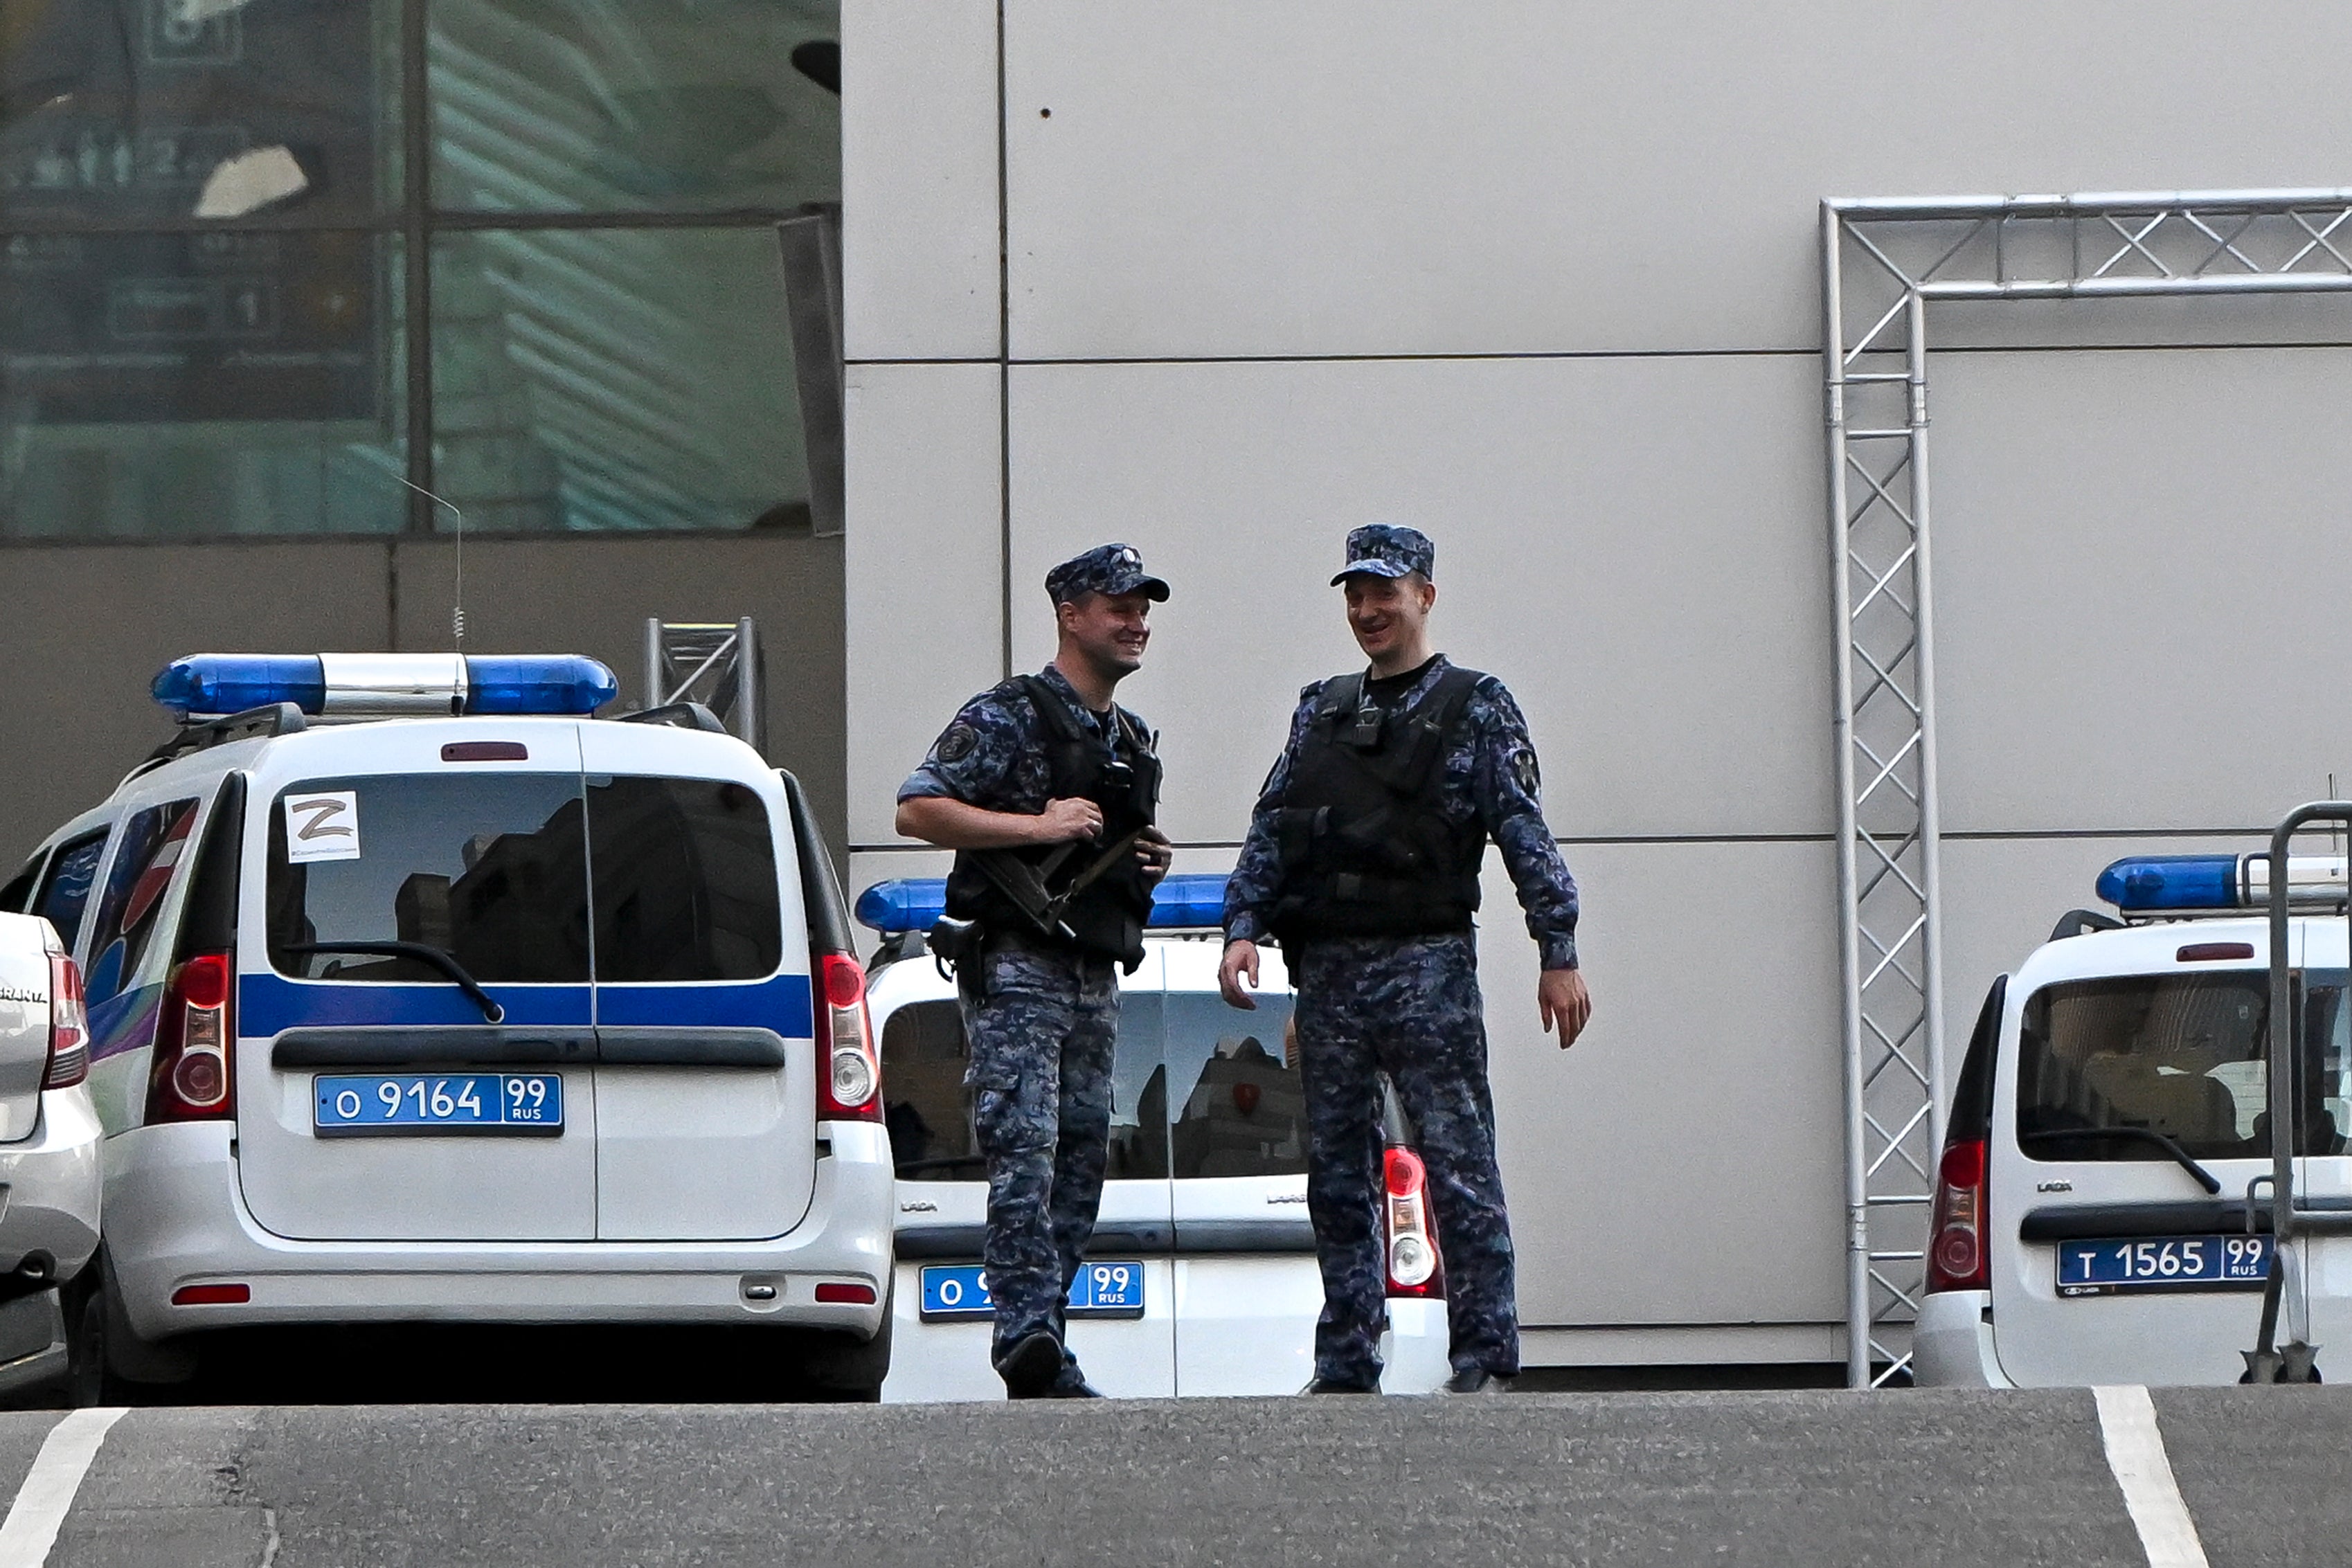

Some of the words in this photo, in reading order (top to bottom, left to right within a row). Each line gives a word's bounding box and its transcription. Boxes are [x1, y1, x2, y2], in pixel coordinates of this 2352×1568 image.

[291, 799, 354, 841] Z
[377, 1081, 481, 1119] 9164
[507, 1079, 546, 1108] 99
[512, 1108, 541, 1120] RUS
[2115, 1241, 2205, 1277] 1565
[2227, 1239, 2263, 1265] 99
[1093, 1267, 1129, 1292] 99
[2231, 1265, 2258, 1276] RUS
[1098, 1293, 1125, 1304] RUS
